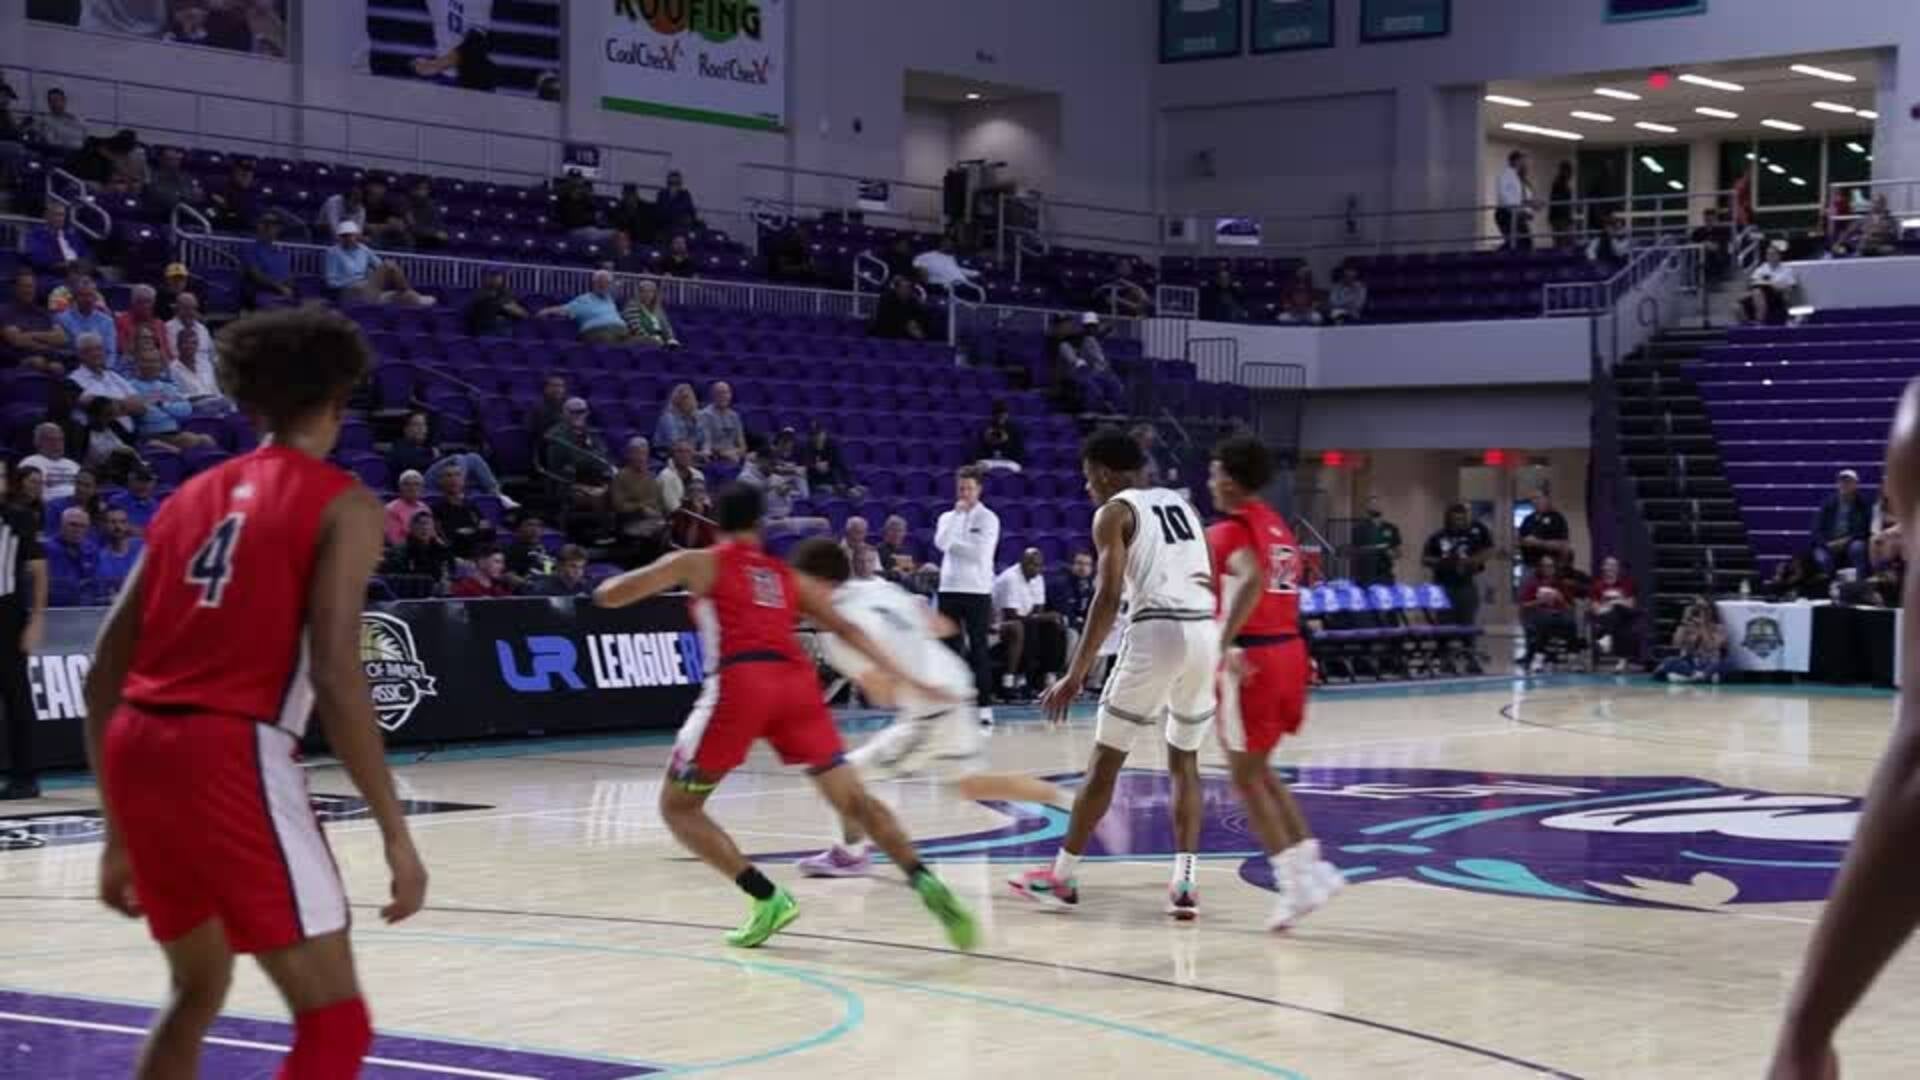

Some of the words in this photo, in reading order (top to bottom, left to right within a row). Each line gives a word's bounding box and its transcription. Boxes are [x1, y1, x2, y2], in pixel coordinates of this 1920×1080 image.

[1152, 505, 1195, 544] 10
[184, 511, 245, 608] 4
[586, 632, 704, 688] LEAGUER
[371, 683, 409, 702] ASSIC
